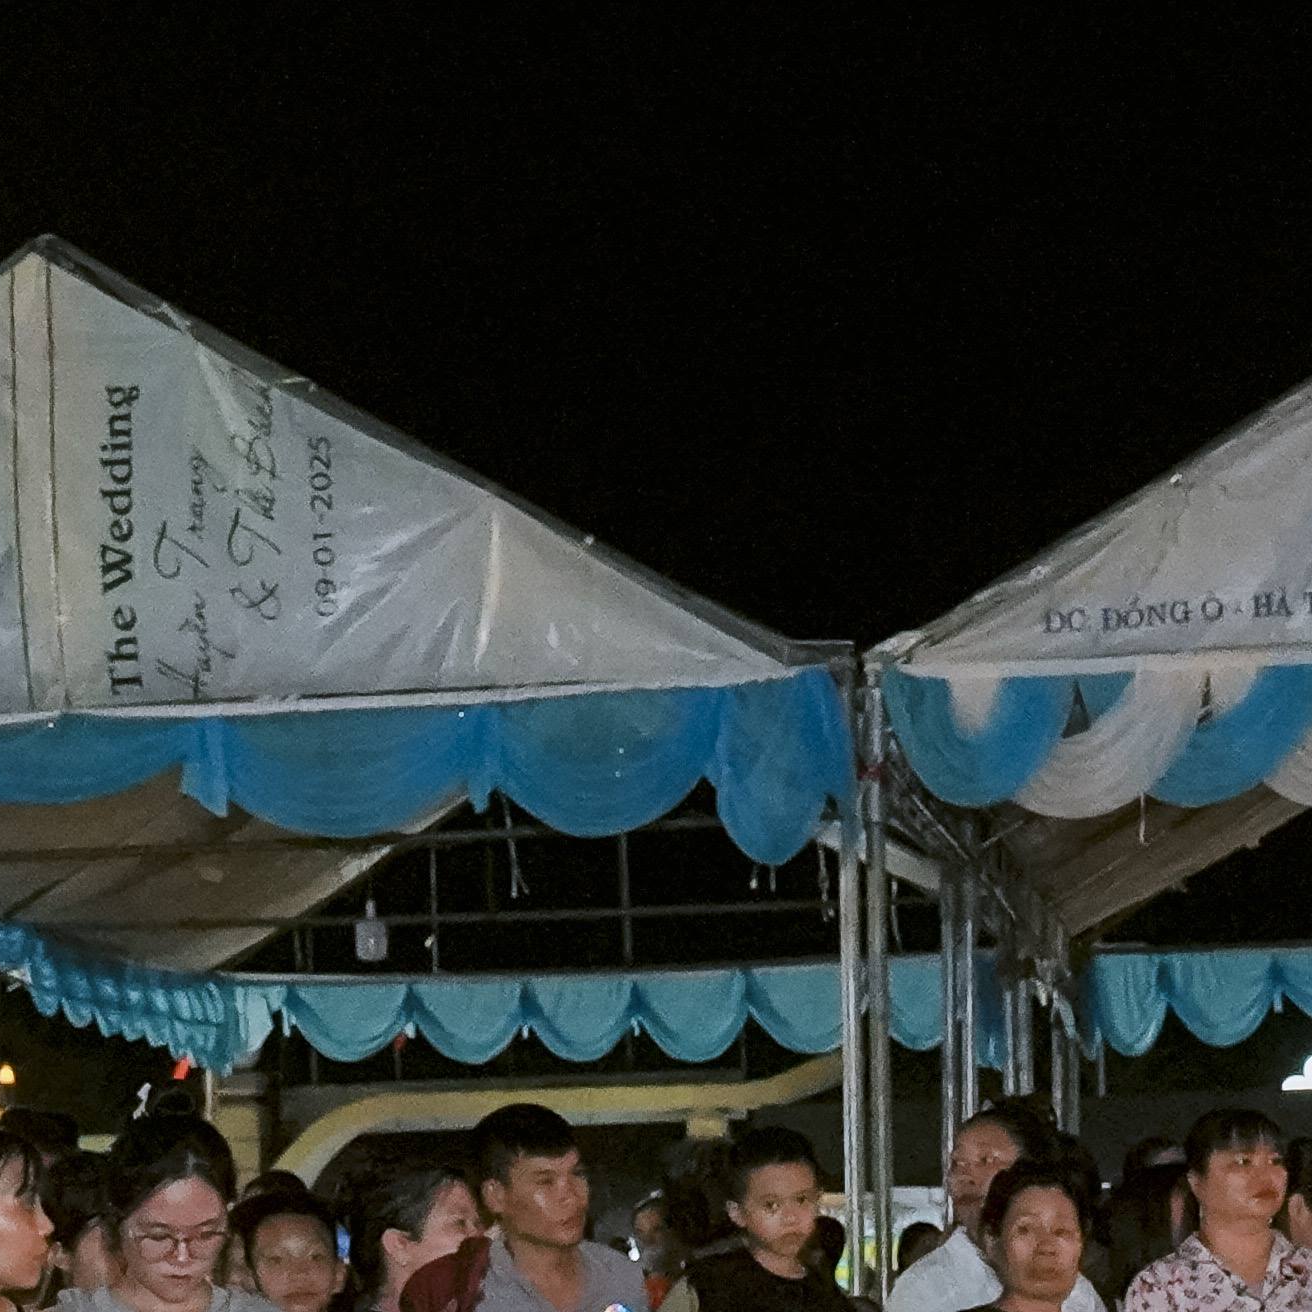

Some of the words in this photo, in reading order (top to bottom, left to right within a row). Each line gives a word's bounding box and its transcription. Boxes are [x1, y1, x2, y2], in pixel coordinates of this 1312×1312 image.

[98, 384, 141, 594] Wedding
[228, 581, 282, 620] &
[106, 605, 144, 696] The
